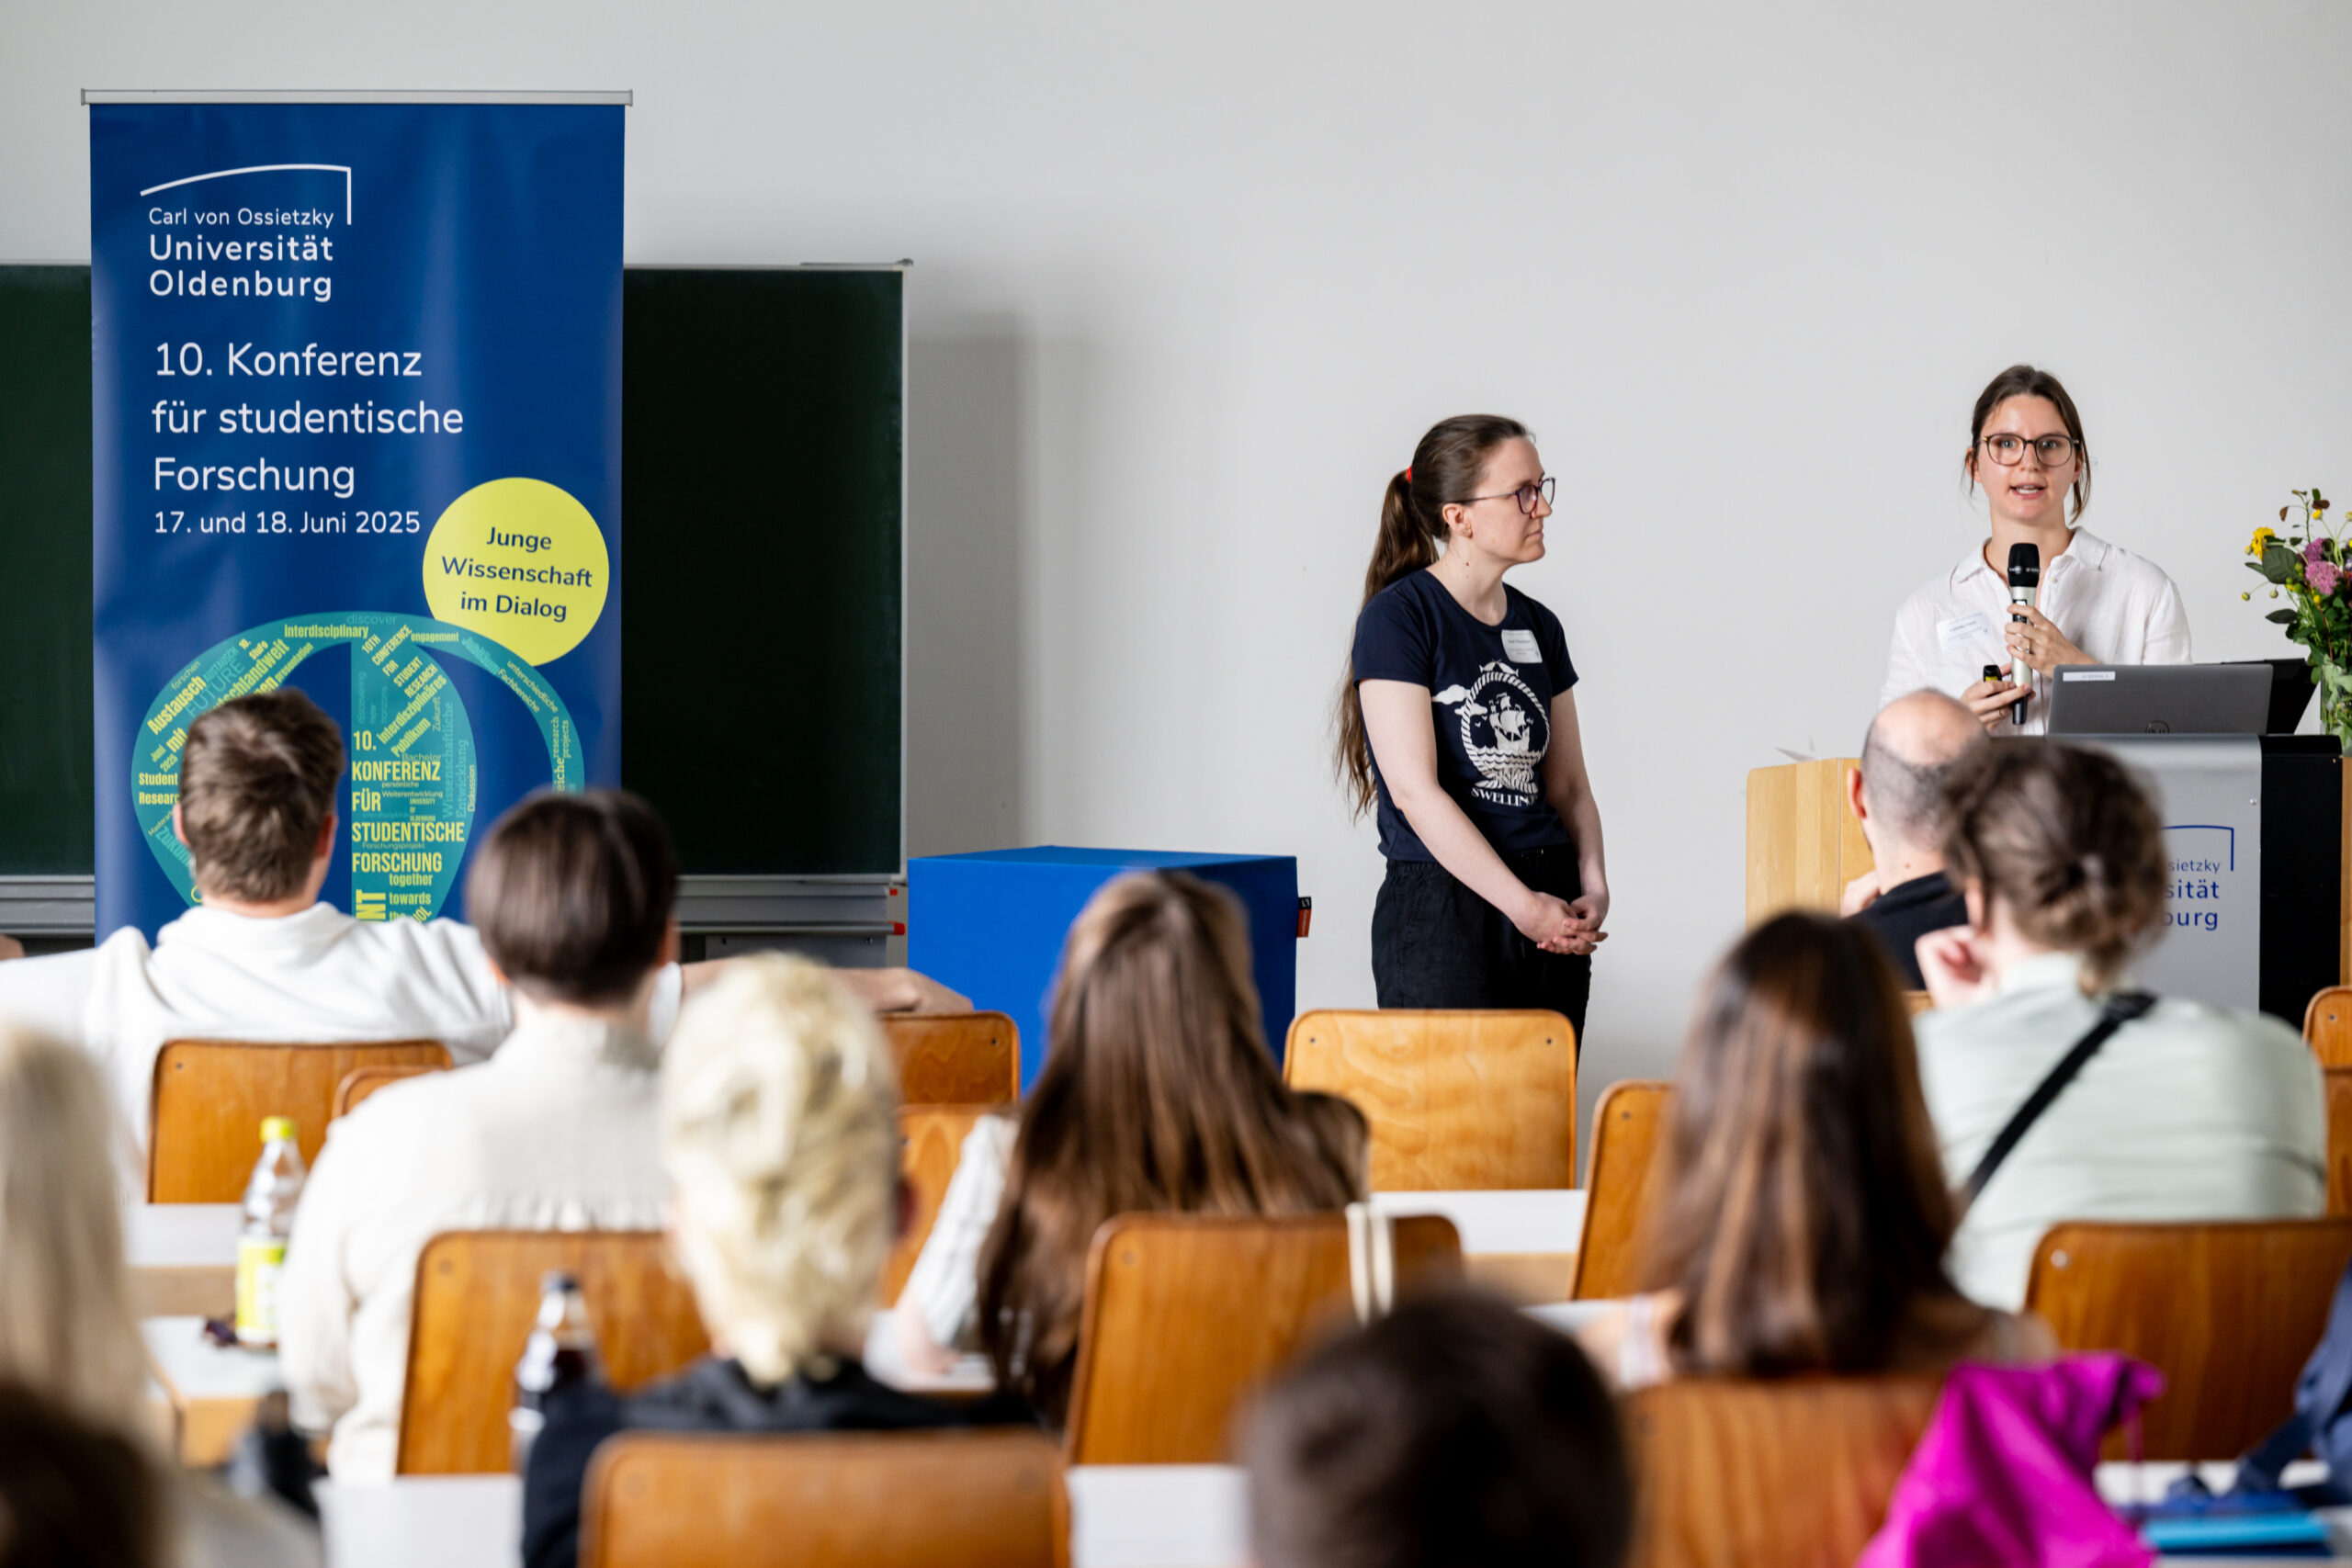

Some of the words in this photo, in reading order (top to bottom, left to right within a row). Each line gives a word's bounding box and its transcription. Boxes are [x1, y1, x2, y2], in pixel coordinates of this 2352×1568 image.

[149, 208, 187, 225] Carl
[194, 212, 230, 225] von
[237, 208, 334, 229] Ossietzky
[150, 234, 334, 261] Universität
[149, 269, 332, 302] Oldenburg
[156, 342, 212, 377] 10.
[228, 342, 423, 377] Konferenz
[152, 400, 207, 434] für
[219, 400, 464, 434] studentische
[154, 457, 356, 499] Forschung
[154, 511, 191, 534] 17.
[199, 511, 246, 534] und
[255, 511, 293, 534] 18.
[300, 511, 346, 534] Juni
[356, 511, 420, 534] 2025
[486, 526, 552, 553] Junge
[441, 555, 593, 588] Wissenschaft
[346, 614, 397, 625] discover
[460, 591, 488, 612] im
[495, 593, 568, 623] Dialog
[284, 625, 369, 638] Interdisciplinary
[410, 631, 459, 642] engagement
[371, 625, 413, 666] CONFERENCE
[382, 660, 399, 677] FOR
[393, 656, 424, 688] STUDENT
[403, 662, 438, 699] RESEARCH
[185, 657, 245, 719] FUTURE
[497, 668, 540, 713] Fachbereiche
[146, 675, 208, 736] Austausch
[376, 675, 447, 744] Interdisziplinäres
[353, 730, 377, 750] 10.
[390, 717, 432, 758] Publikum
[352, 761, 441, 782] KONFERENZ
[442, 701, 454, 819] Wissenschaftliche
[139, 773, 178, 785] Student
[139, 792, 180, 805] Researc
[352, 788, 381, 812] FÜR
[352, 821, 465, 842] STUDENTISCHE
[352, 852, 443, 873] FORSCHUNG
[389, 874, 434, 887] together
[356, 889, 386, 922] NT
[389, 892, 432, 905] towards
